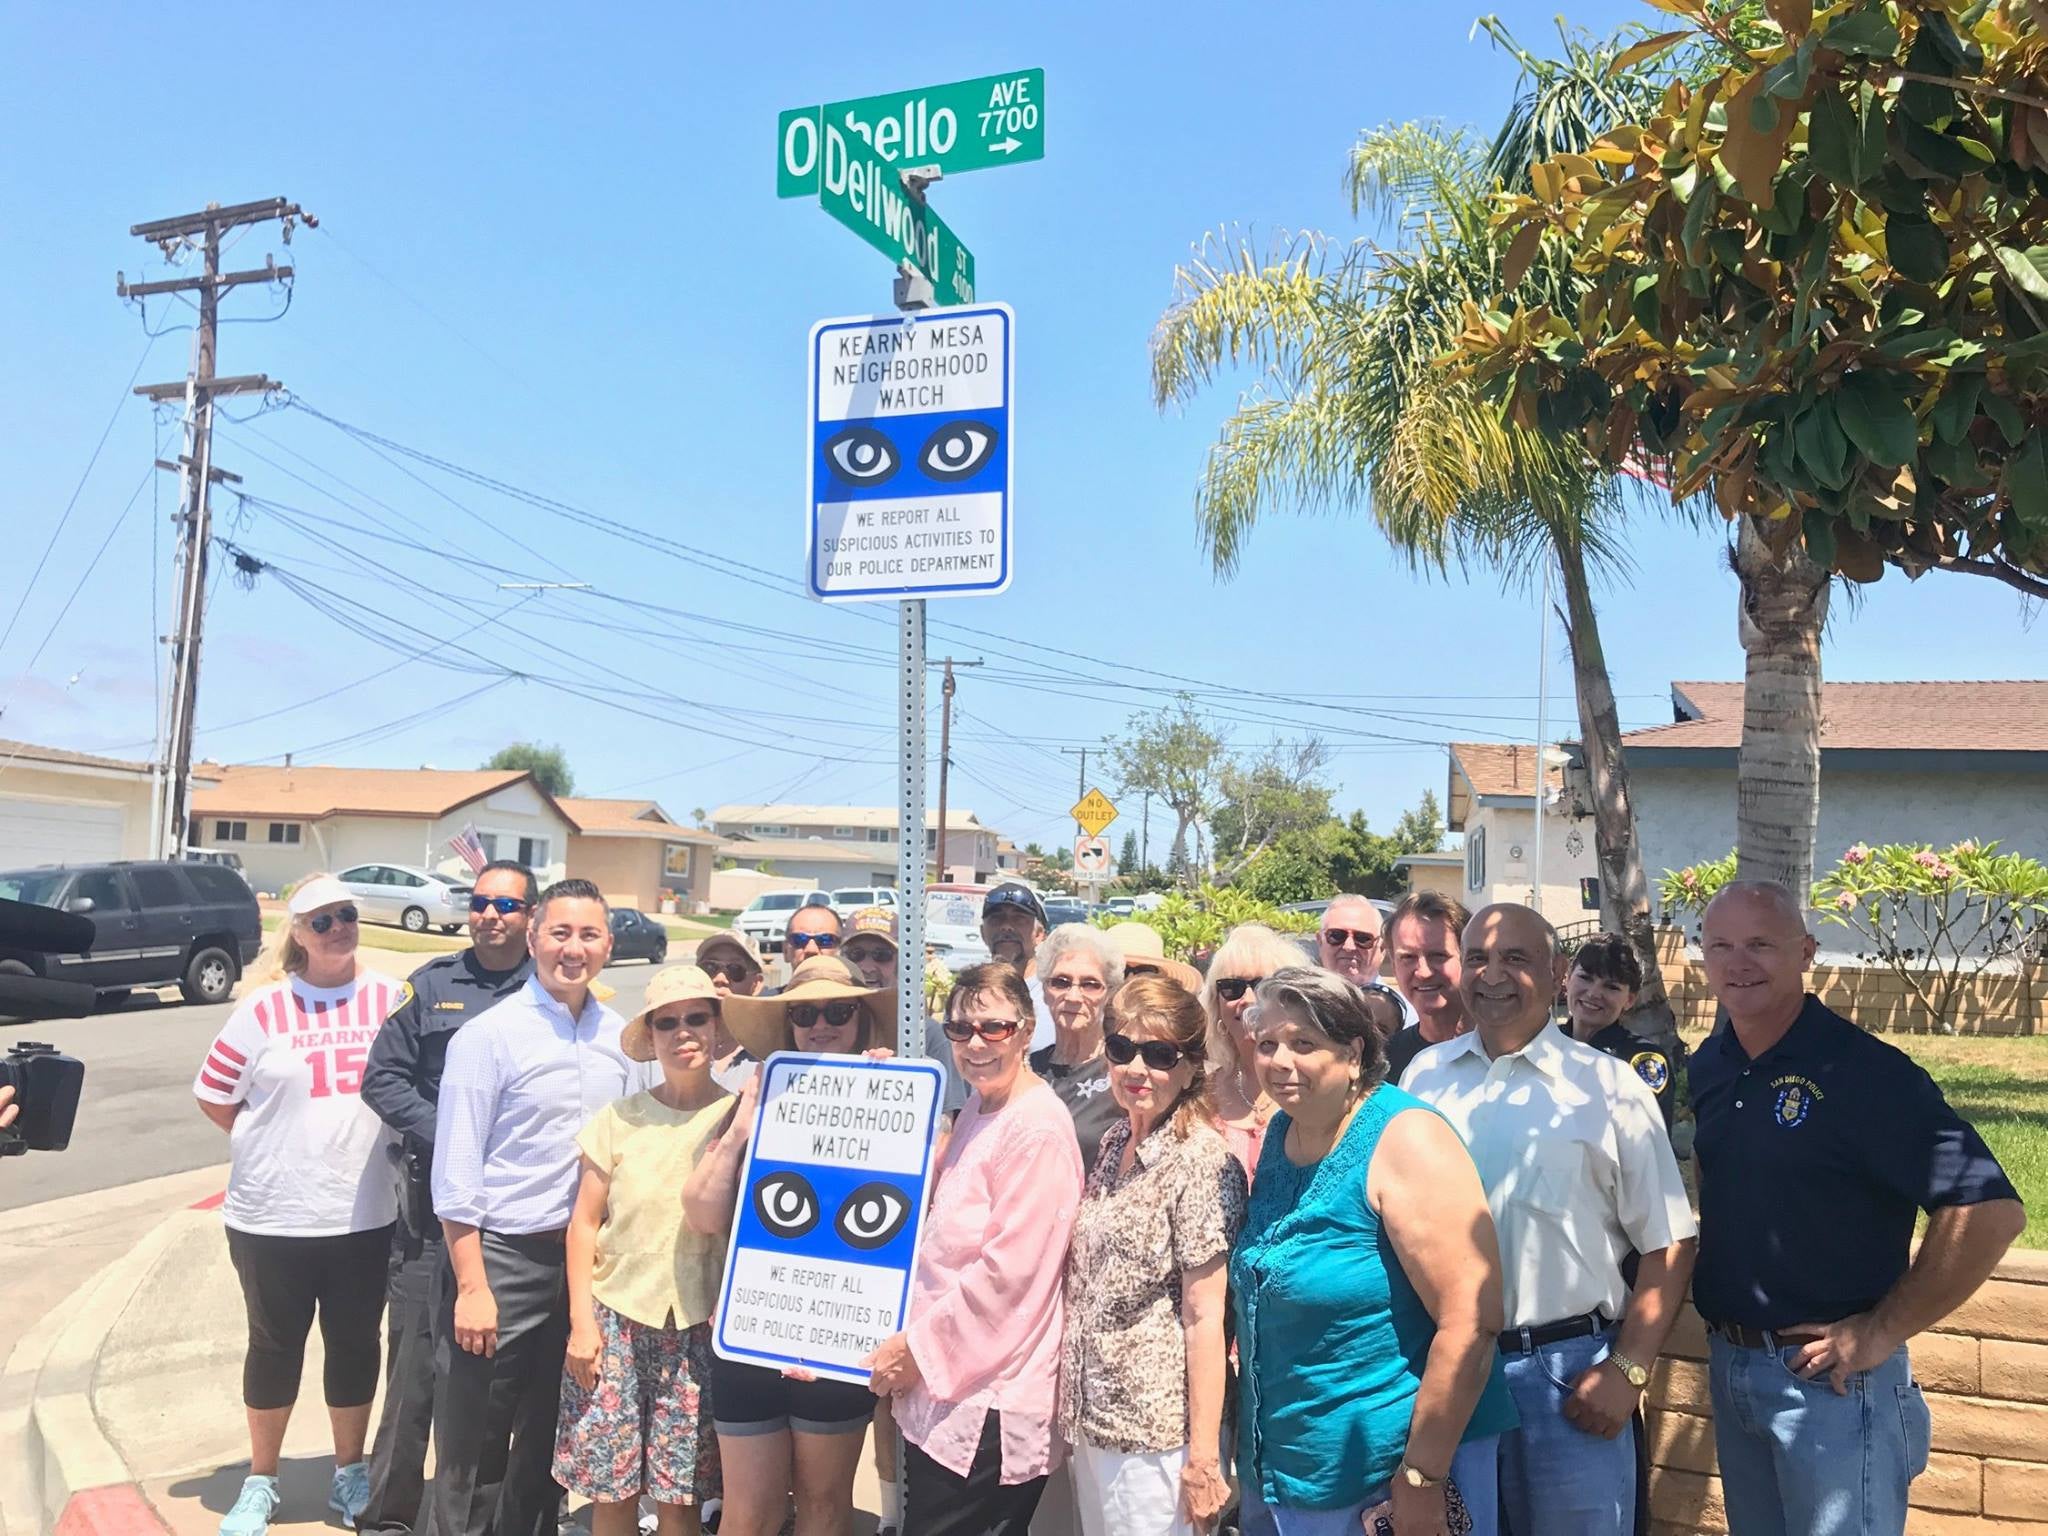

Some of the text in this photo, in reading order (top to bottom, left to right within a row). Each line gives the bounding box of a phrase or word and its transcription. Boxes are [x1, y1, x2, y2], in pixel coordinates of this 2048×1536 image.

[989, 78, 1031, 109] AVE
[978, 104, 1038, 137] 7700
[784, 98, 958, 177] Oello
[824, 122, 939, 283] Dellwood
[956, 246, 967, 276] ST
[840, 324, 984, 357] KEARNY MESA
[833, 352, 988, 386] NEIGHBORHOOD
[880, 384, 943, 409] WATCH
[856, 507, 960, 527] WE REPORT ALL
[823, 528, 995, 553] SUSPICIOUS ACTIVITIES TO
[826, 553, 995, 577] OUR POLICE DEPARTMENT
[1076, 811, 1113, 821] OUTLET
[1087, 799, 1102, 808] NO
[291, 1028, 377, 1049] KEARNY
[304, 1047, 367, 1098] 15
[785, 1072, 915, 1103] KEARNY MESA
[1770, 1077, 1784, 1088] SAN
[775, 1102, 916, 1134] NEIGHBORHOOD
[812, 1134, 870, 1161] WATCH
[770, 1265, 863, 1294] WE REPORT ALL
[734, 1287, 893, 1327] SUSPICIOUS ACTIVITIES TO
[733, 1315, 886, 1353] OUR POLICE DEPARTMEN
